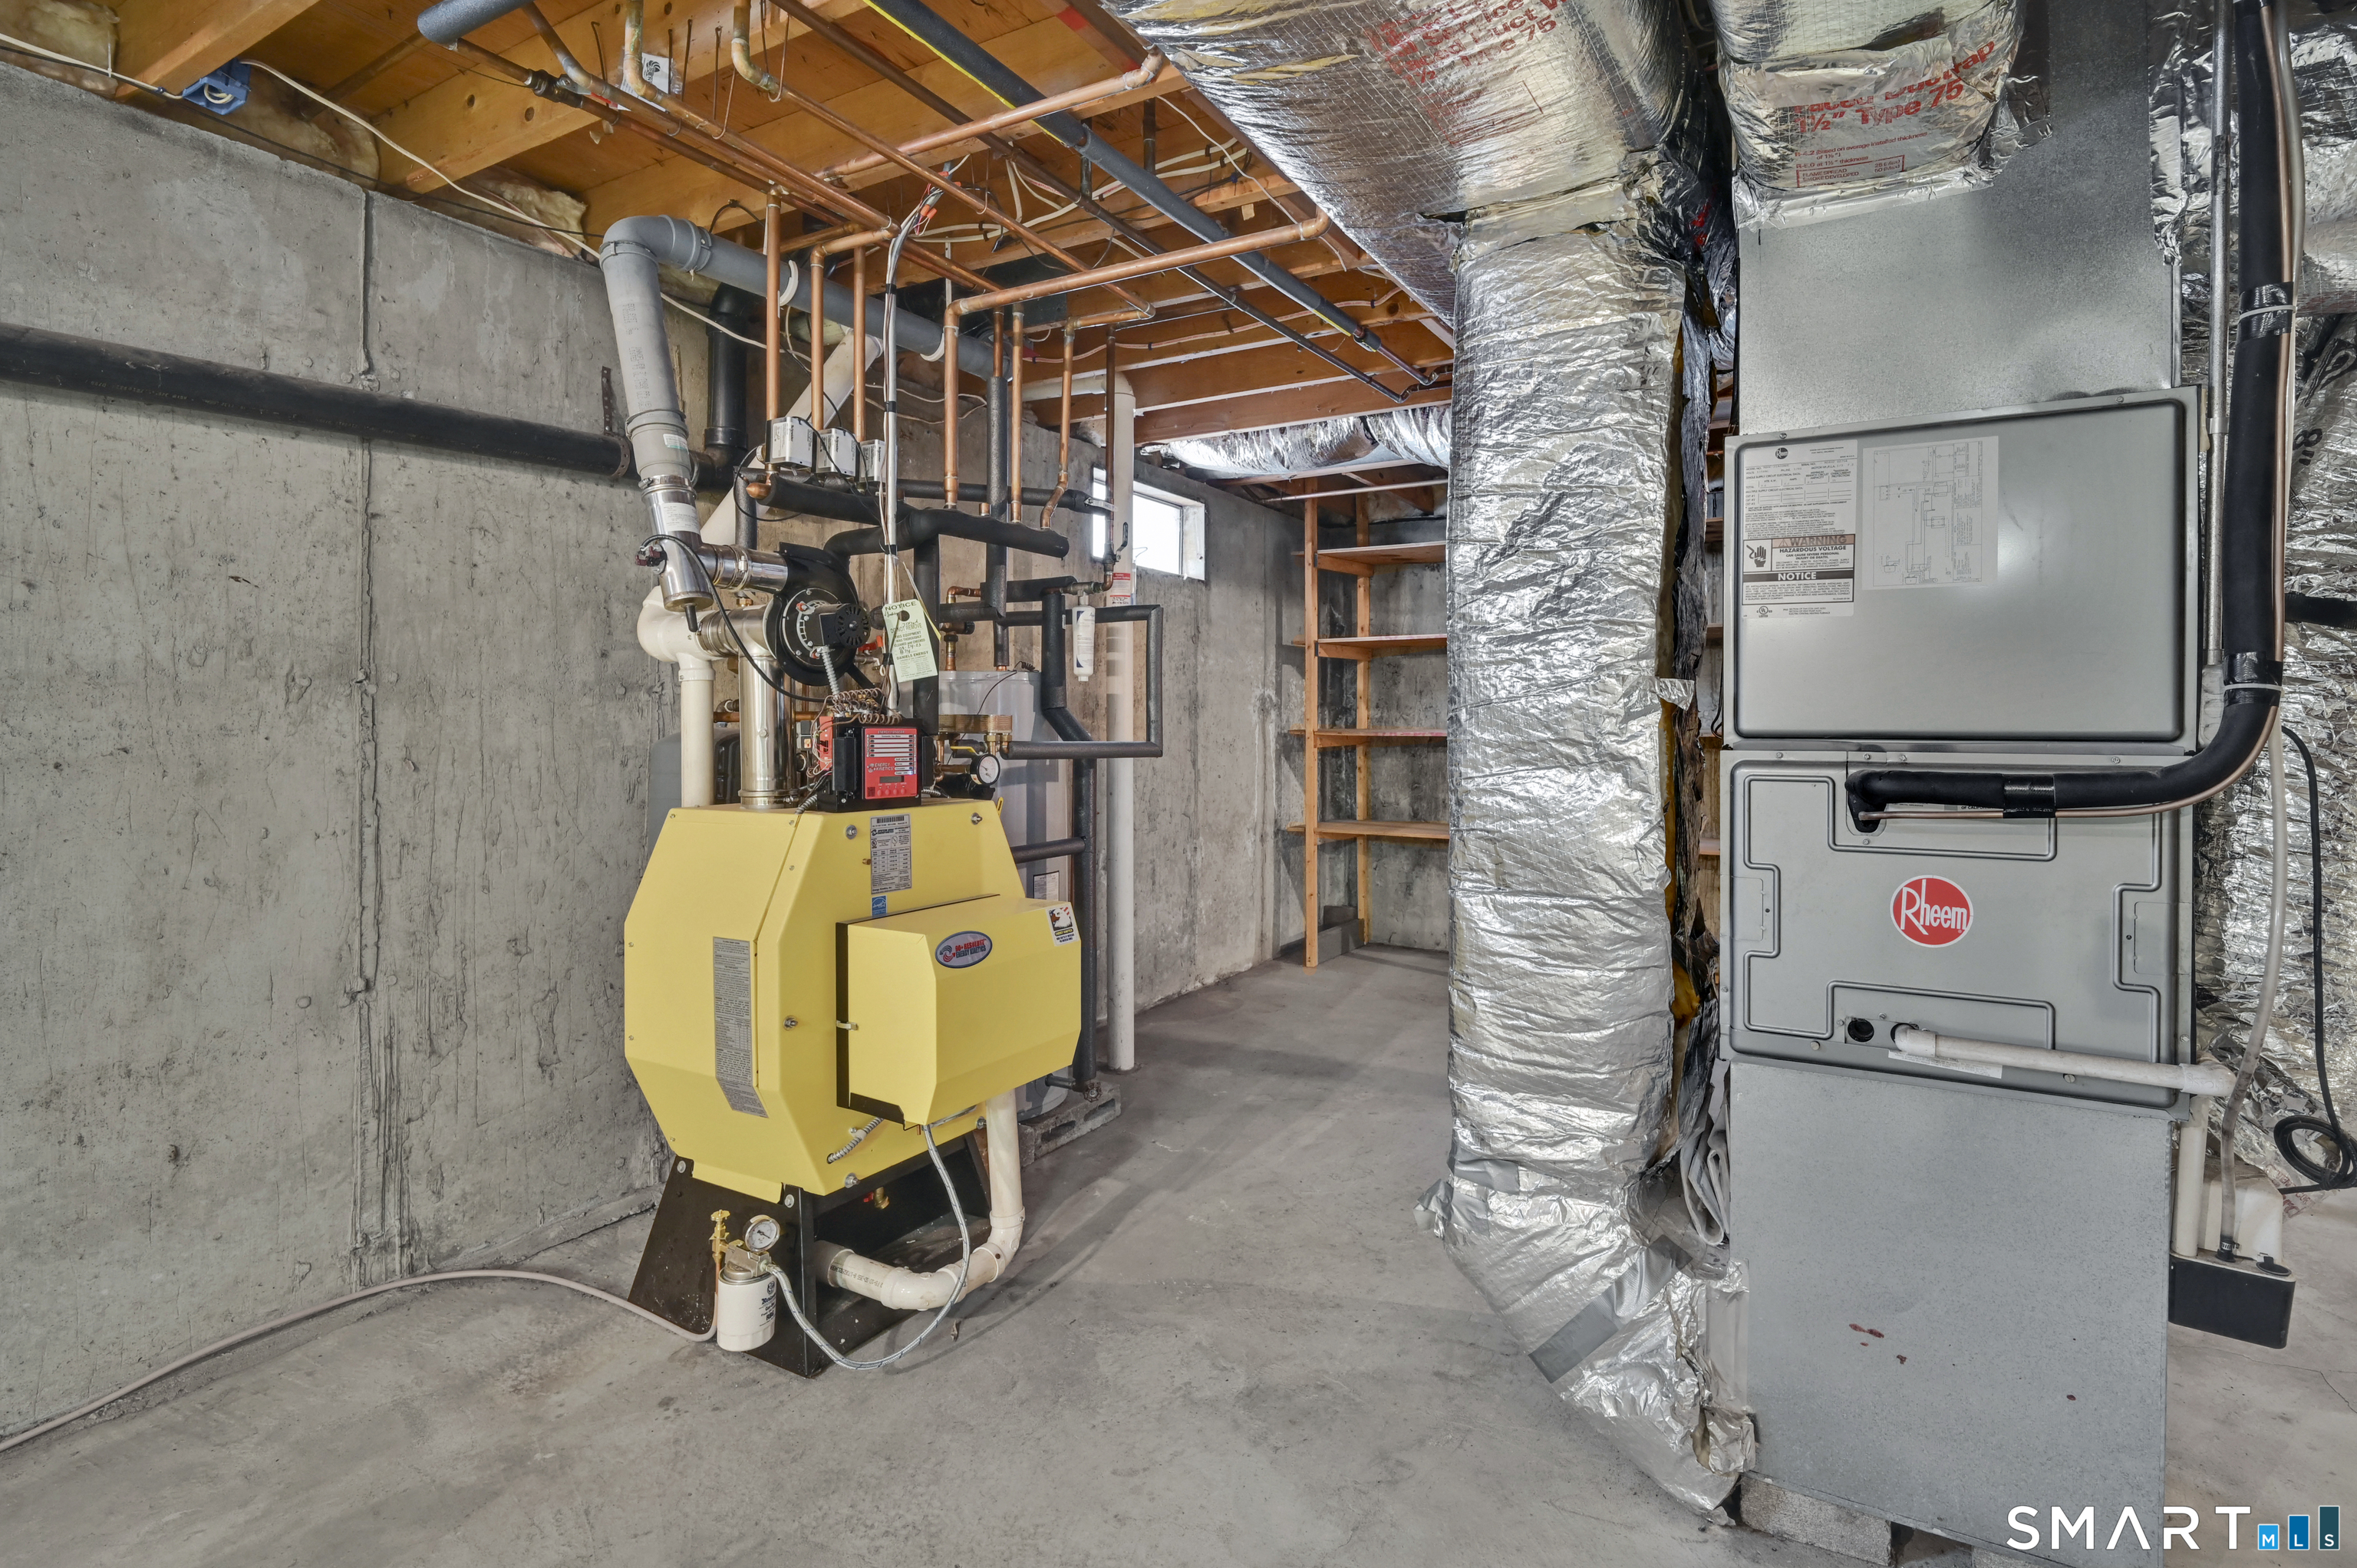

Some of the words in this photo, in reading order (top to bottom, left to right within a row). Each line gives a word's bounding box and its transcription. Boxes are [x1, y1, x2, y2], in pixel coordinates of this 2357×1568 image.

[1519, 15, 1557, 41] 75
[1855, 99, 1921, 127] Type
[1929, 77, 1964, 108] 75
[1846, 143, 1870, 151] average
[1871, 137, 1897, 147] installed
[1897, 131, 1928, 142] thickness
[1839, 156, 1869, 164] thickness
[1825, 171, 1860, 180] DEVELOPED
[1790, 535, 1847, 546] WARNING
[1778, 572, 1817, 581] NOTICE
[885, 601, 917, 611] NOTICE
[1900, 878, 1967, 935] Rheem
[956, 949, 970, 958] ENERGY
[969, 944, 987, 955] KINETICS
